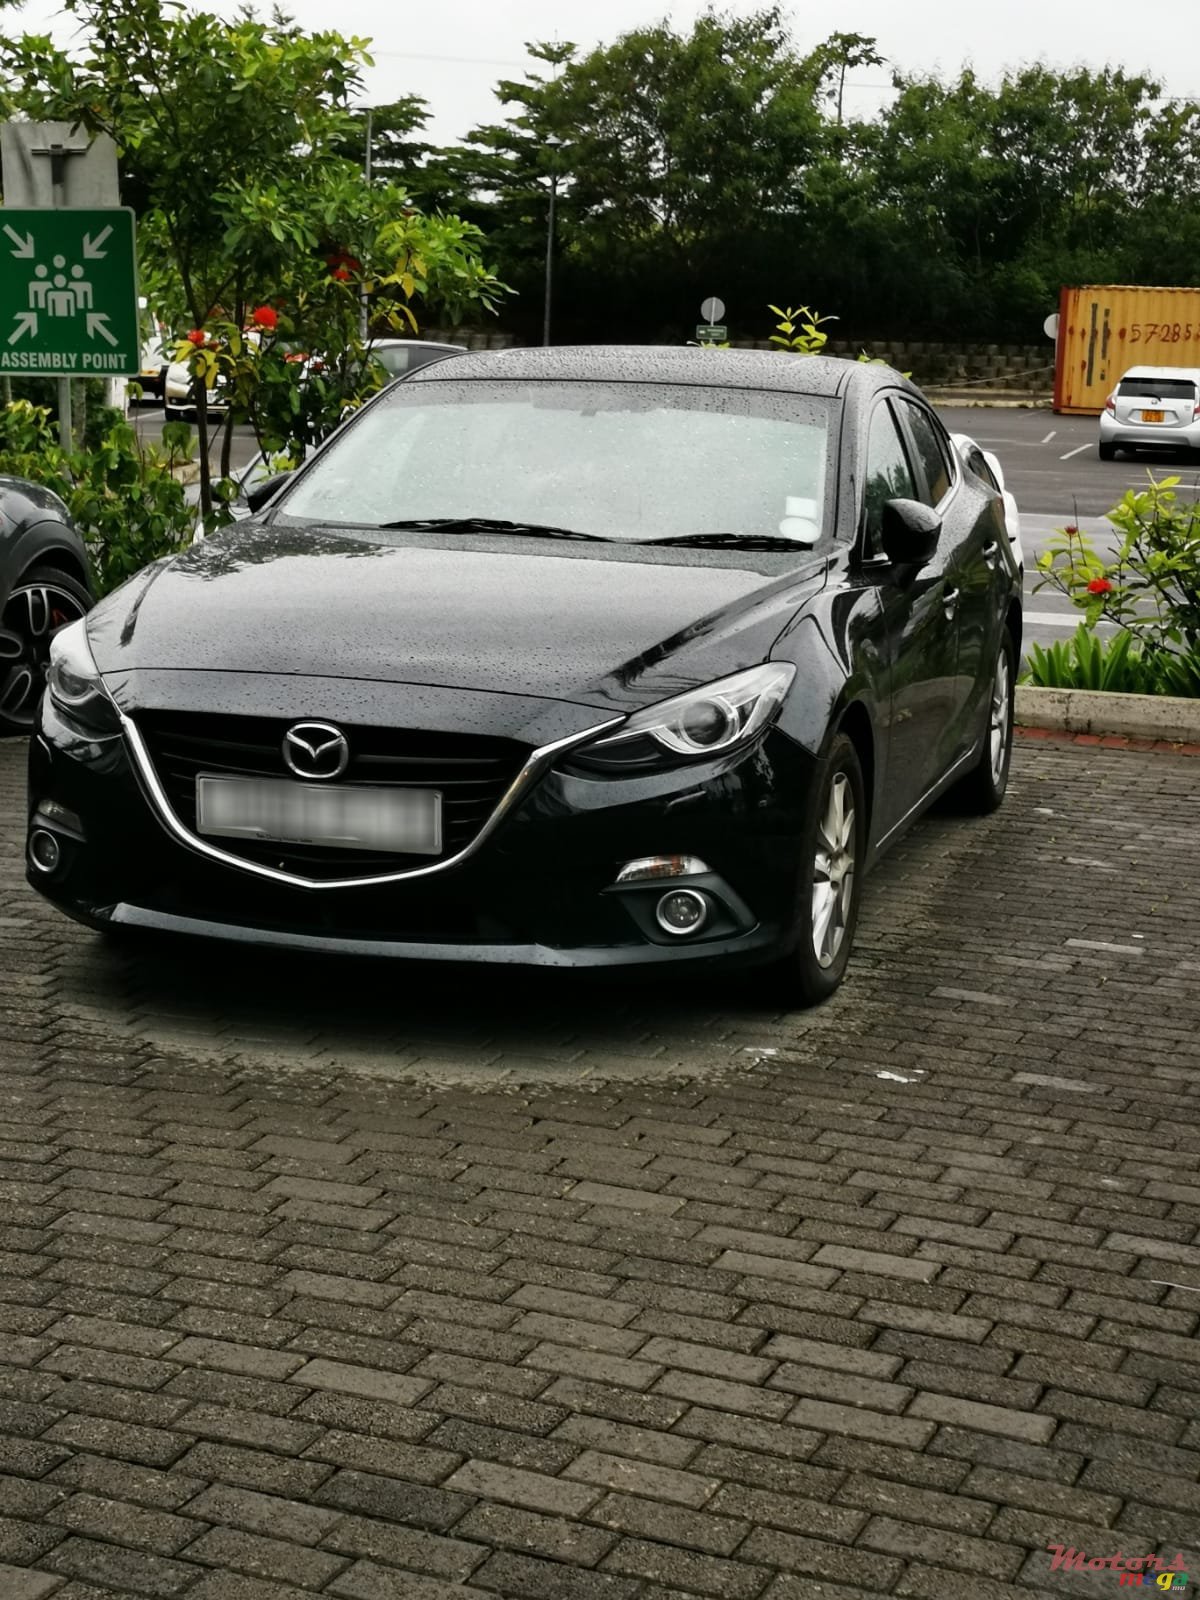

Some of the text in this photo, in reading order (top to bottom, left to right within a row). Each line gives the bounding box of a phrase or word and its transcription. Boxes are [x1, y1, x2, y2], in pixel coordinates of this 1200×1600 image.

[1129, 323, 1200, 344] 57285
[1, 351, 127, 369] ASSEMBLY POINT
